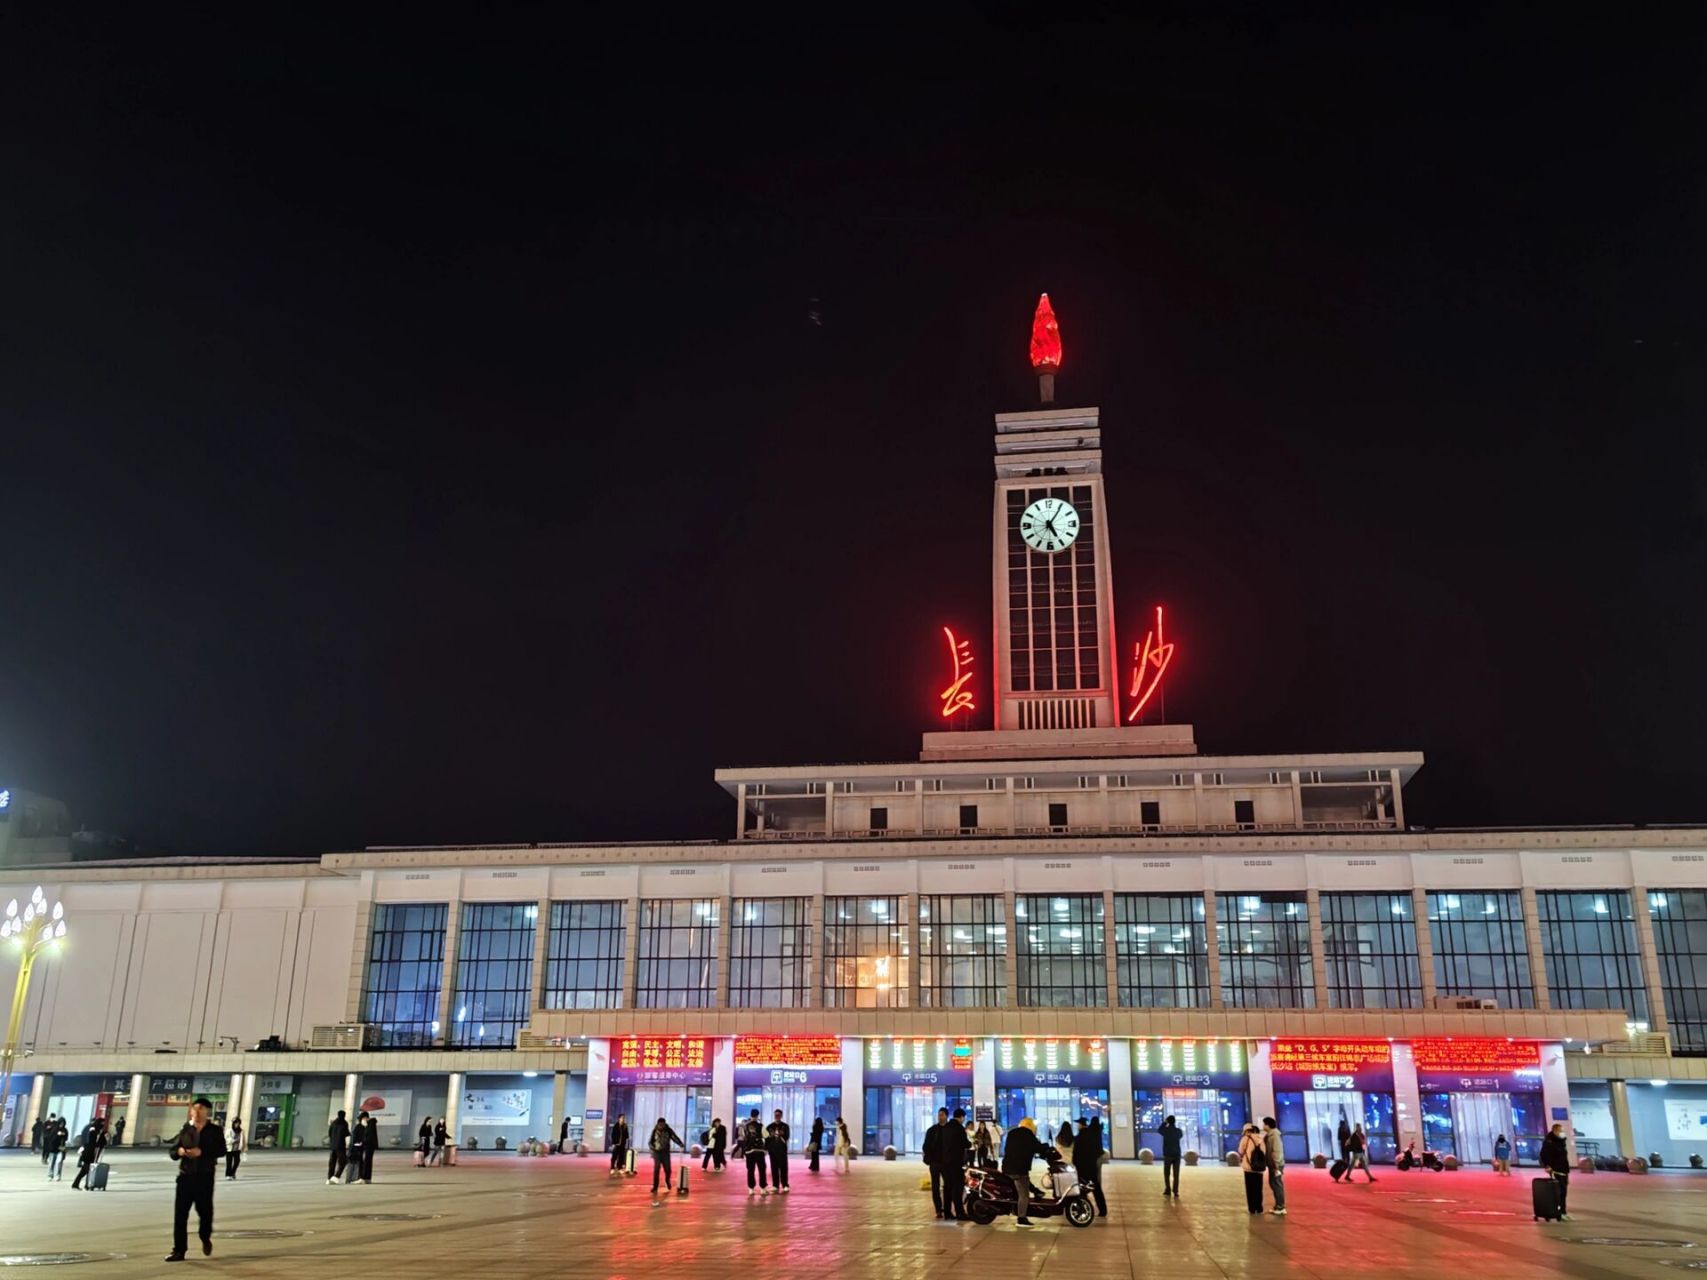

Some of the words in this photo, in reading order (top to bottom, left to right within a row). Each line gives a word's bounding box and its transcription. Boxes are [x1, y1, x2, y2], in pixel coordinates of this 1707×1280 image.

[1045, 500, 1053, 509] 12
[1023, 522, 1032, 531] 9
[1068, 520, 1076, 528] 3
[1046, 541, 1054, 550] 6
[1129, 606, 1174, 721] 沙
